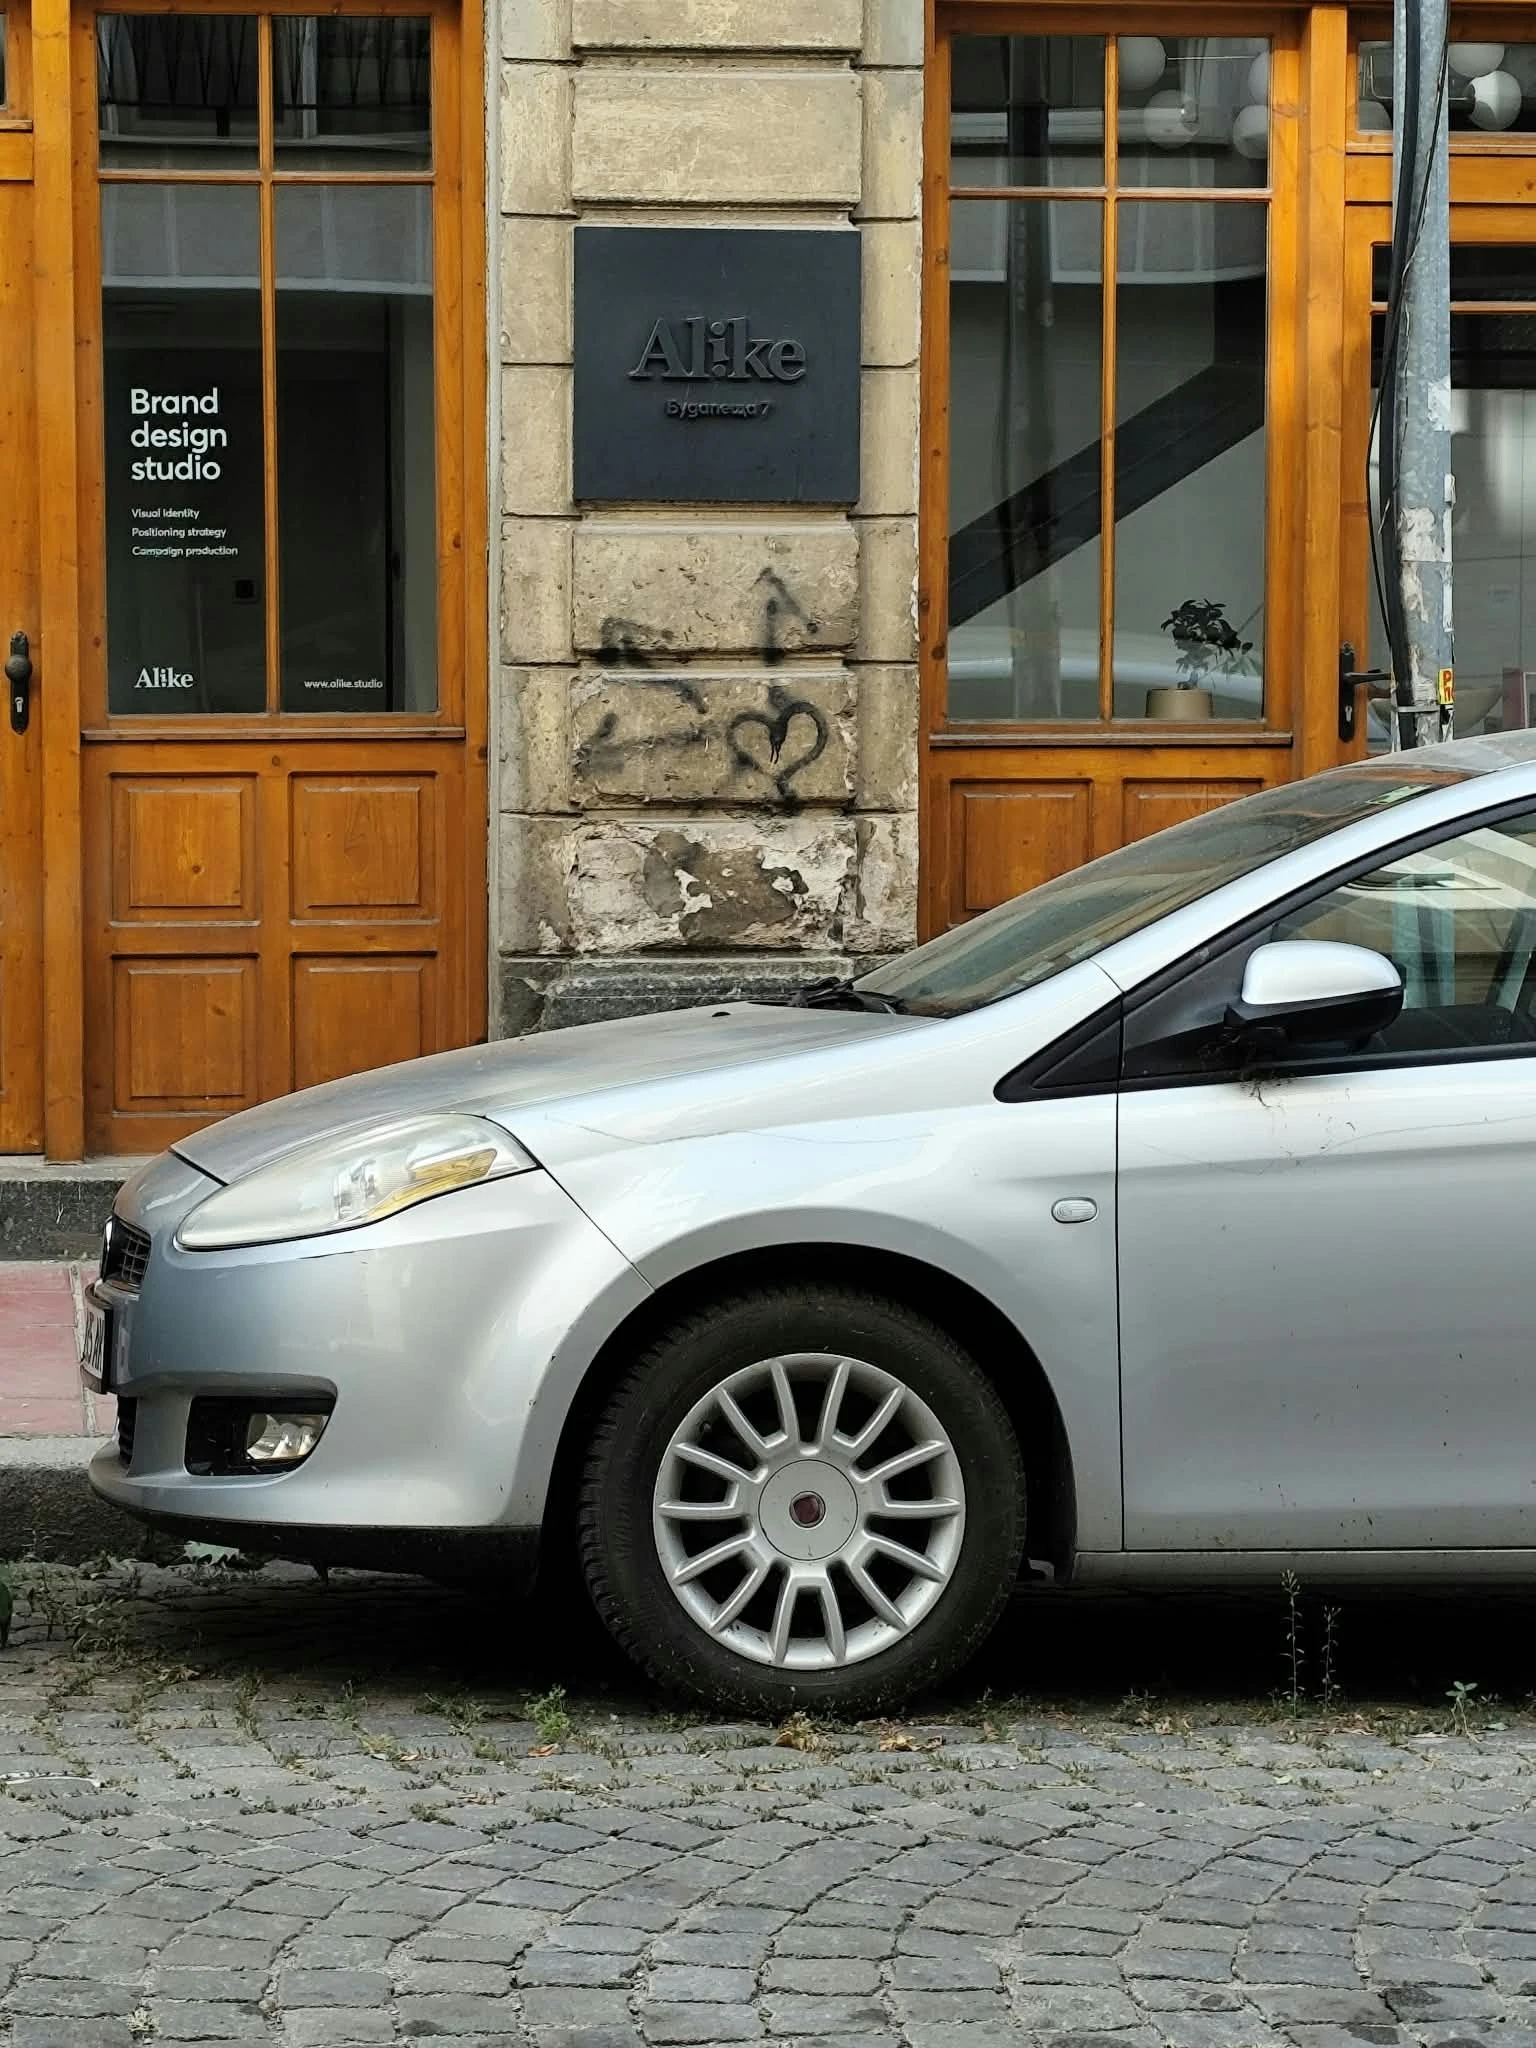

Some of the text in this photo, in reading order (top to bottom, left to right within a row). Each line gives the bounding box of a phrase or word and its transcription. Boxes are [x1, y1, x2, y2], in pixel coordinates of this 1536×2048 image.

[627, 315, 807, 382] Alike
[130, 386, 219, 415] Brand
[760, 400, 771, 416] 7
[130, 420, 228, 454] design
[130, 453, 221, 481] studio
[131, 507, 161, 518] Visual
[131, 527, 227, 539] Positioning strategy
[131, 545, 239, 558] Campaign production
[133, 666, 194, 689] Alike
[303, 677, 384, 689] www.alike.studio
